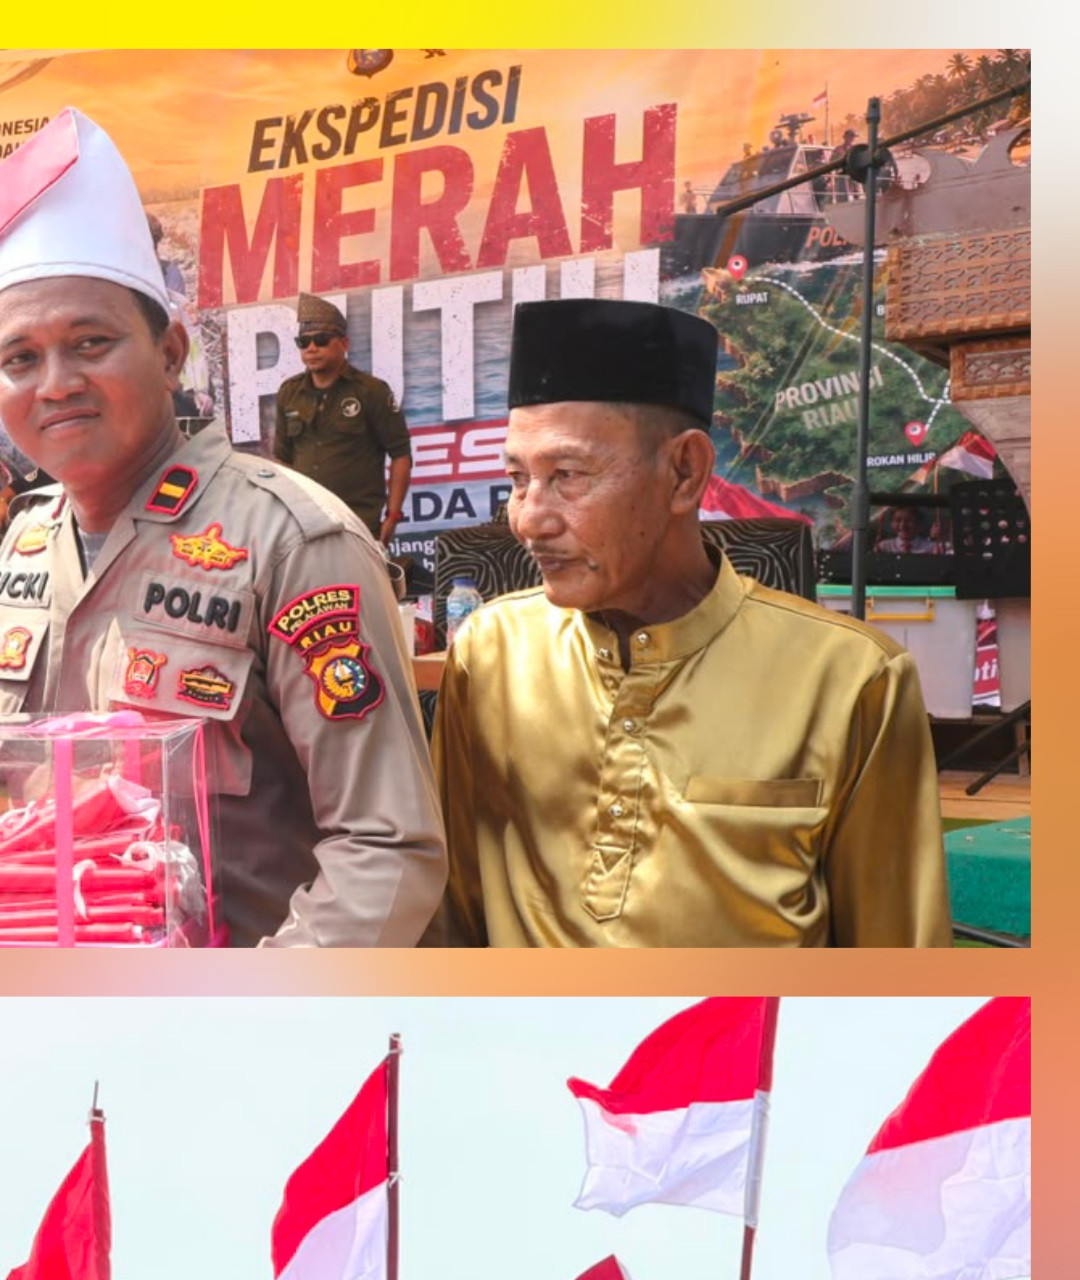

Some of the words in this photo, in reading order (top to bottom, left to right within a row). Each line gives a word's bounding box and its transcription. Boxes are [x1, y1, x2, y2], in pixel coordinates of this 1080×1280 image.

[247, 64, 524, 173] EKSPEDISI
[197, 102, 678, 310] MERAH
[736, 291, 769, 304] RUPAT
[144, 583, 241, 632] POLRI
[277, 589, 351, 632] POLRES
[300, 620, 352, 649] RIAU
